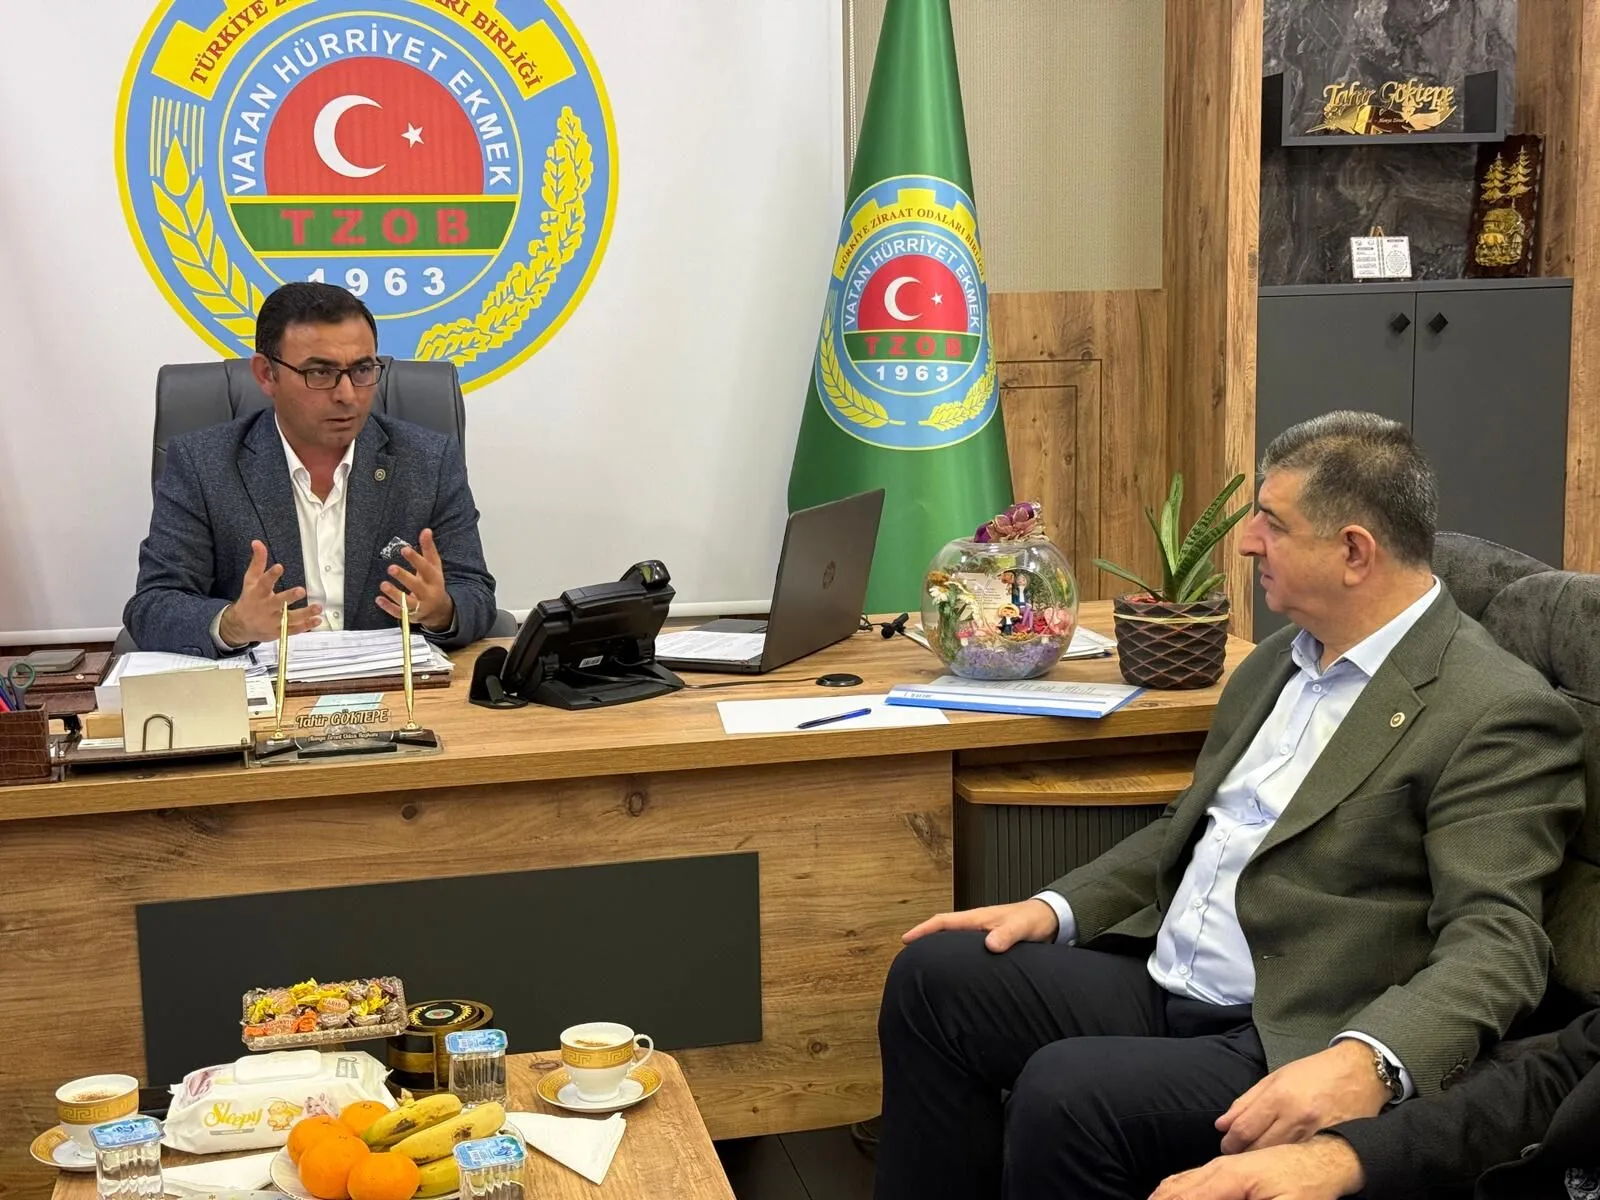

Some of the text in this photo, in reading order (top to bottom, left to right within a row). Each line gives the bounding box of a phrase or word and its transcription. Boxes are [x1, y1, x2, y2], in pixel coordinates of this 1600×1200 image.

[190, 0, 268, 84] TÜRKİYE
[471, 10, 543, 89] BİRLİĞİ
[232, 22, 512, 194] VATAN HÜRRİYET EKMEK
[280, 208, 470, 245] TZOB
[870, 207, 914, 229] ZİRAAT
[916, 208, 966, 236] ODALARI
[845, 236, 981, 328] VATAN HÜRRİYET EKMEK
[864, 335, 962, 358] TZOB
[876, 365, 949, 382] 1963
[297, 709, 389, 728] Tahir GÖKTEPE
[204, 1102, 264, 1130] Sleepy
